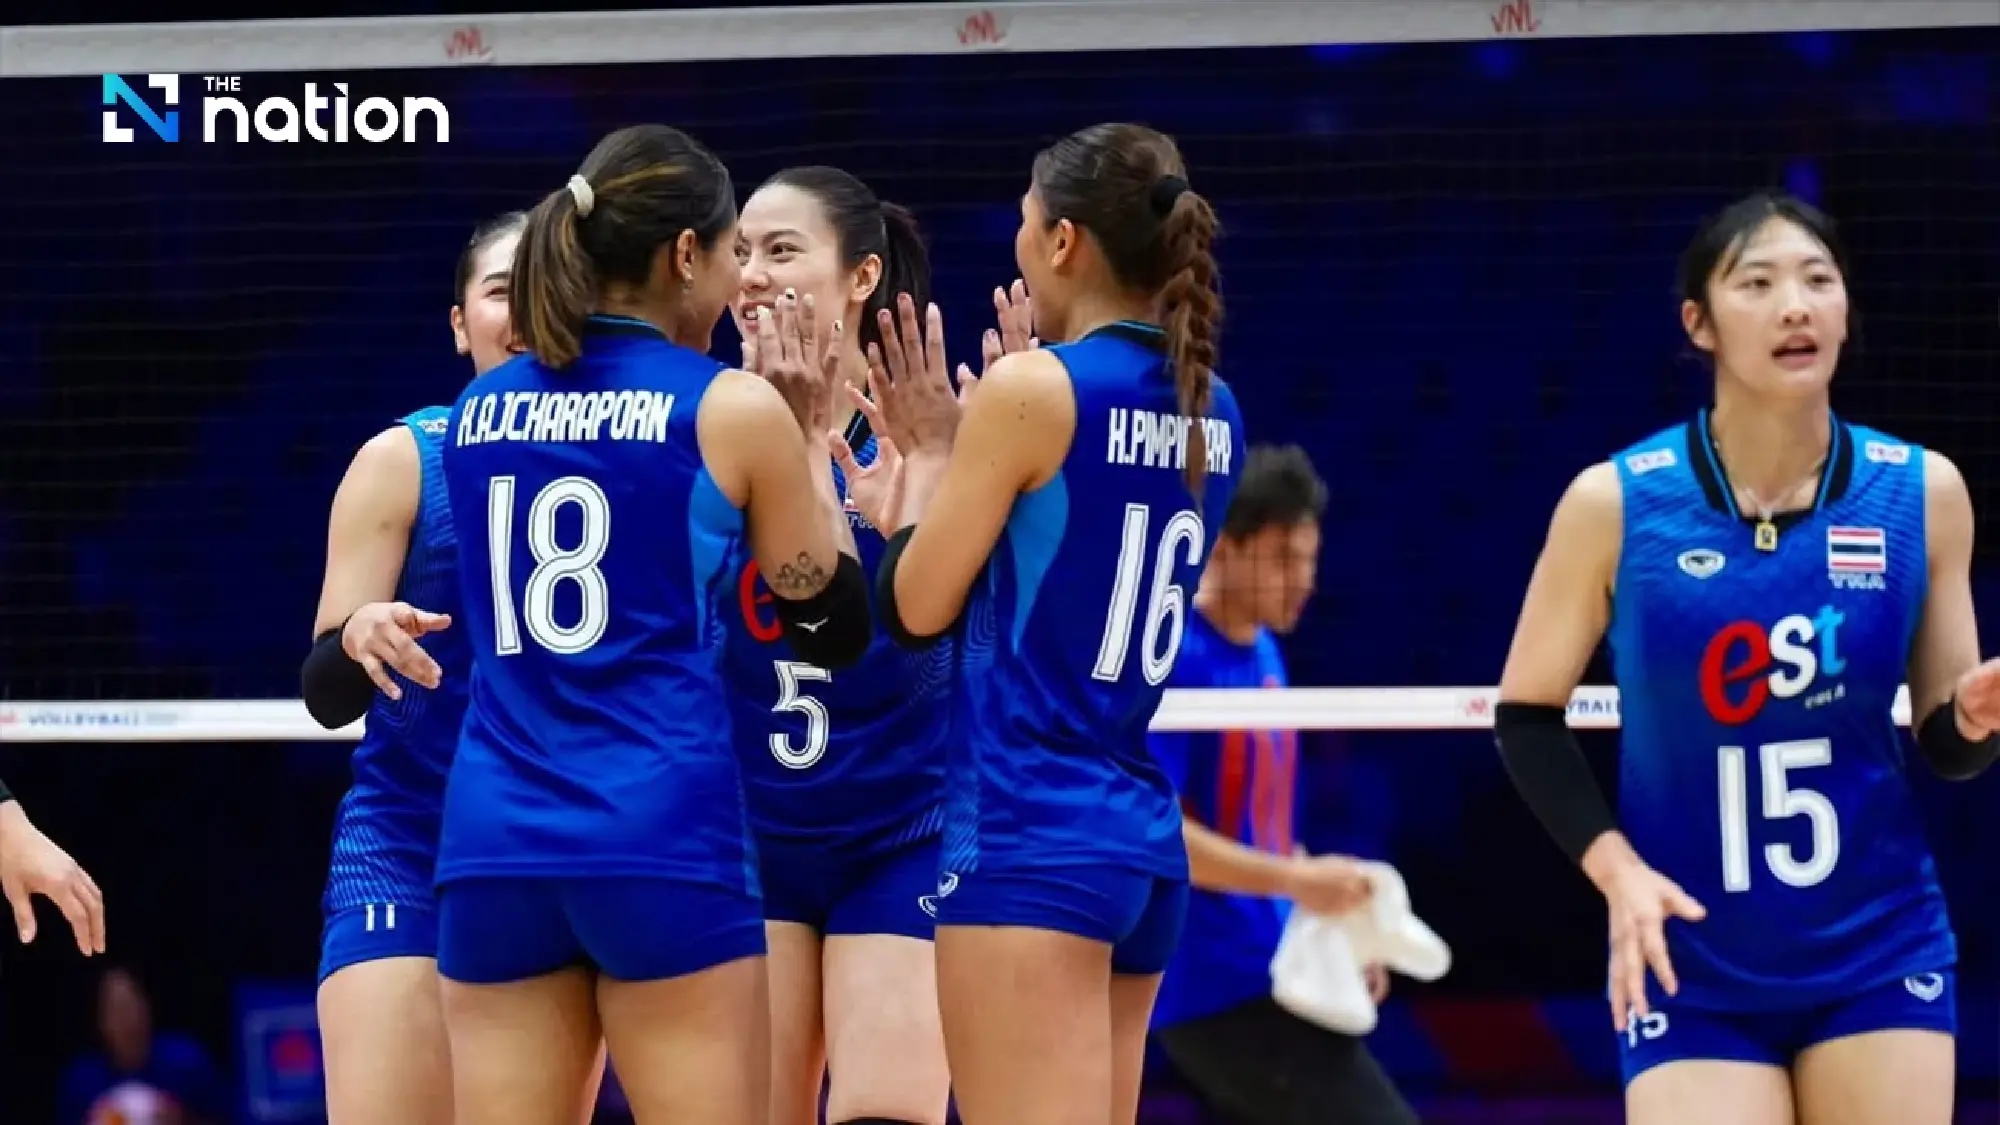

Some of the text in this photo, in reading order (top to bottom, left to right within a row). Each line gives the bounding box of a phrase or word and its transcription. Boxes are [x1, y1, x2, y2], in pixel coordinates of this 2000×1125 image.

[488, 475, 611, 656] 18
[1091, 502, 1205, 686] 16
[769, 659, 832, 770] 5
[1698, 604, 1847, 726] est
[1717, 737, 1840, 893] 15
[365, 902, 395, 931] 11
